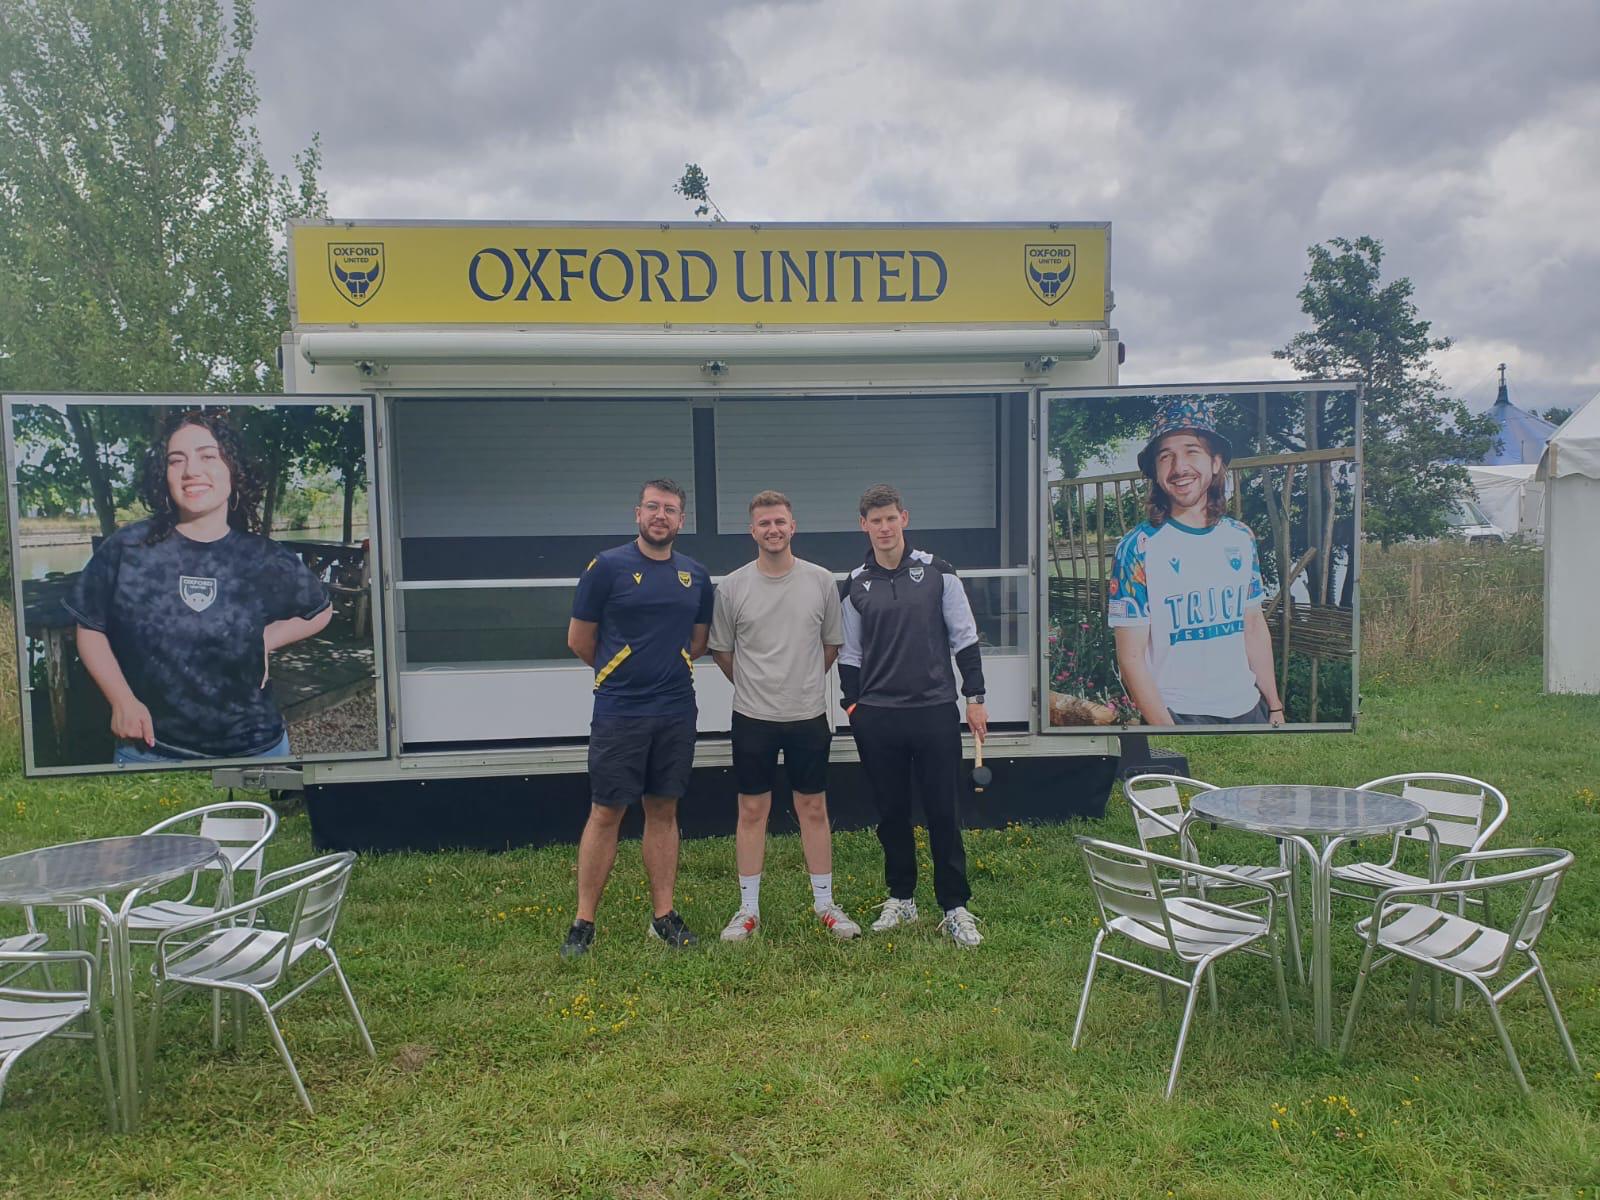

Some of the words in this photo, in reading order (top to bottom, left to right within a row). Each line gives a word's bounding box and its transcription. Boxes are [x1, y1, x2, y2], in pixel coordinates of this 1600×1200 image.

[333, 247, 379, 256] OXFORD
[1029, 249, 1071, 257] OXFORD
[468, 247, 718, 303] OXFORD
[733, 249, 948, 304] UNITED
